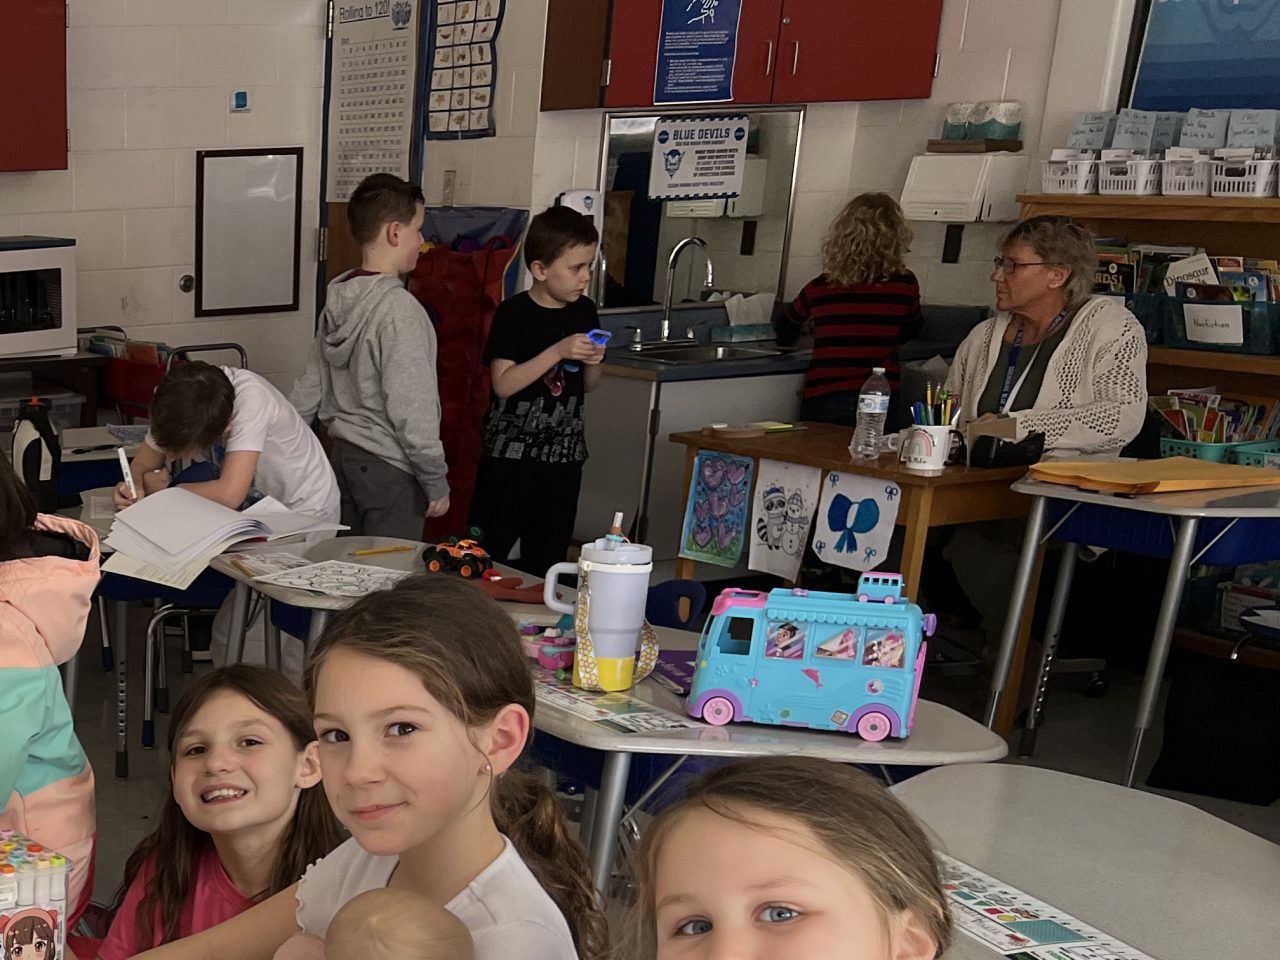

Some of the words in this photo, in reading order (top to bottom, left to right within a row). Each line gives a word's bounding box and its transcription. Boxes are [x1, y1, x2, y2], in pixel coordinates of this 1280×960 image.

[673, 129, 695, 140] BLUE
[698, 128, 730, 139] DEVILS
[1095, 273, 1123, 284] RDS!
[1166, 266, 1210, 287] Dinosaur
